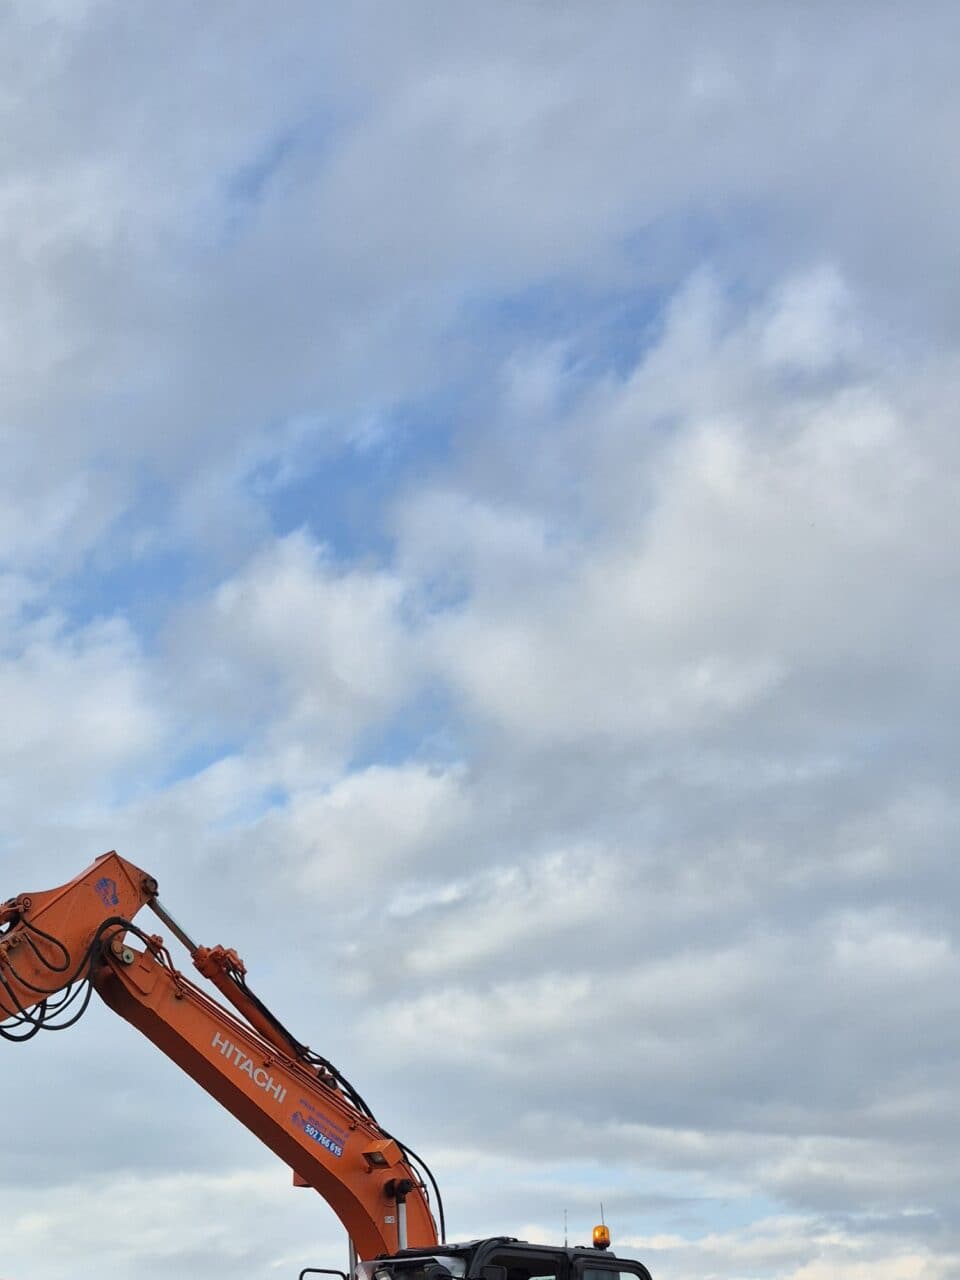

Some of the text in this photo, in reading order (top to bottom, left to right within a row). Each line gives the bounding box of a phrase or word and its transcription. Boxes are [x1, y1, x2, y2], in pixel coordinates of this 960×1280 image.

[211, 1032, 287, 1104] HITACHI
[304, 1123, 319, 1139] 502
[318, 1132, 331, 1148] 766
[330, 1143, 343, 1157] 615
